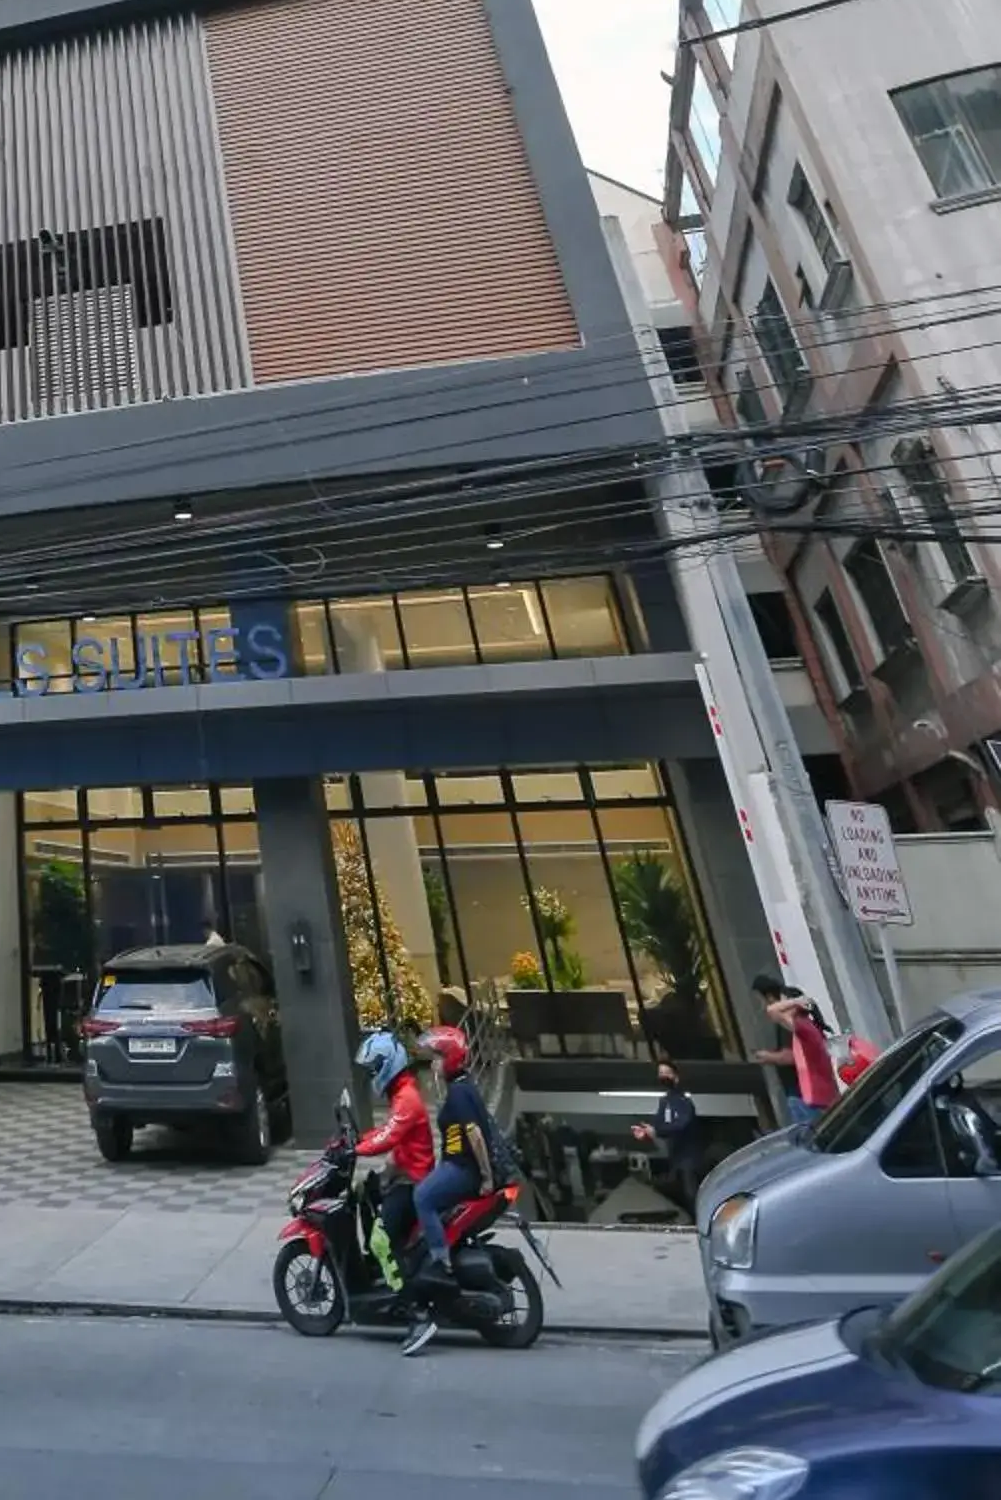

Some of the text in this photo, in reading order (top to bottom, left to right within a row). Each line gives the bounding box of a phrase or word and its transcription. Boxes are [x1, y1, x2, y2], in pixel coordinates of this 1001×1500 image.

[72, 625, 288, 692] SUITES
[850, 809, 865, 823] NO
[840, 827, 885, 844] LOADING
[858, 847, 878, 862] AND
[844, 865, 901, 884] UNLOADING
[856, 886, 900, 903] ANYTIME
